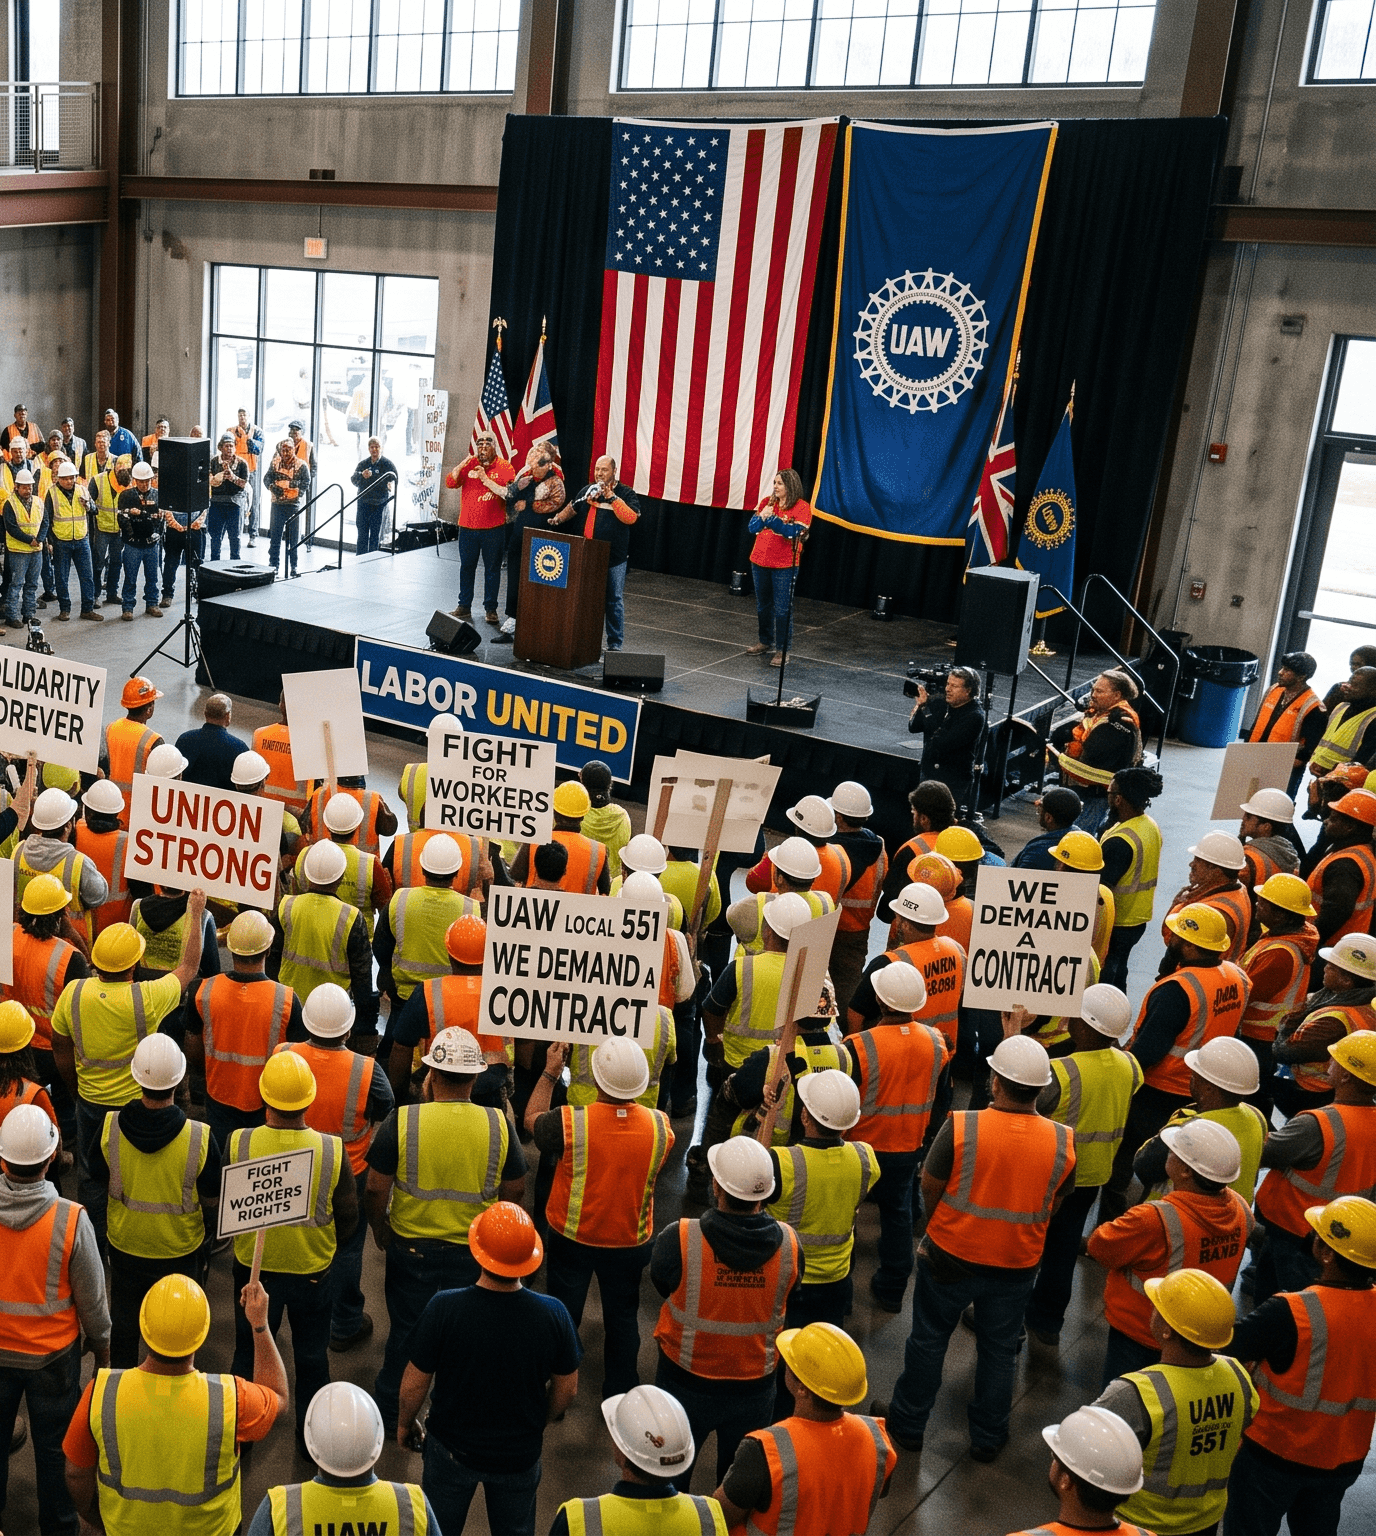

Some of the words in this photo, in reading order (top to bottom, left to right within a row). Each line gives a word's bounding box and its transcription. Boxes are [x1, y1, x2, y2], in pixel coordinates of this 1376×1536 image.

[890, 323, 953, 358] UAW
[361, 660, 477, 719] LABOR
[487, 689, 627, 753] UNITED
[443, 733, 539, 768] FIGHT
[472, 766, 507, 782] FOR
[430, 777, 549, 813] WORKERS
[151, 786, 262, 843] UNION
[441, 804, 536, 837] RIGHTS
[133, 829, 272, 891] STRONG
[1008, 880, 1059, 905] WE
[494, 894, 560, 931] UAW
[565, 915, 615, 937] LOCAL
[621, 908, 660, 941] 551
[980, 905, 1089, 932] DEMAND
[1016, 931, 1036, 948] A
[492, 942, 531, 977] WE
[537, 946, 640, 987] DEMAND
[643, 967, 655, 989] A
[971, 948, 1082, 996] CONTRACT
[488, 986, 648, 1038] CONTRACT
[247, 1160, 291, 1180] FIGHT
[253, 1176, 283, 1192] FOR
[230, 1185, 302, 1210] WORKERS
[238, 1200, 291, 1222] RIGHTS
[1189, 1392, 1234, 1425] UAW
[1189, 1429, 1228, 1456] 551
